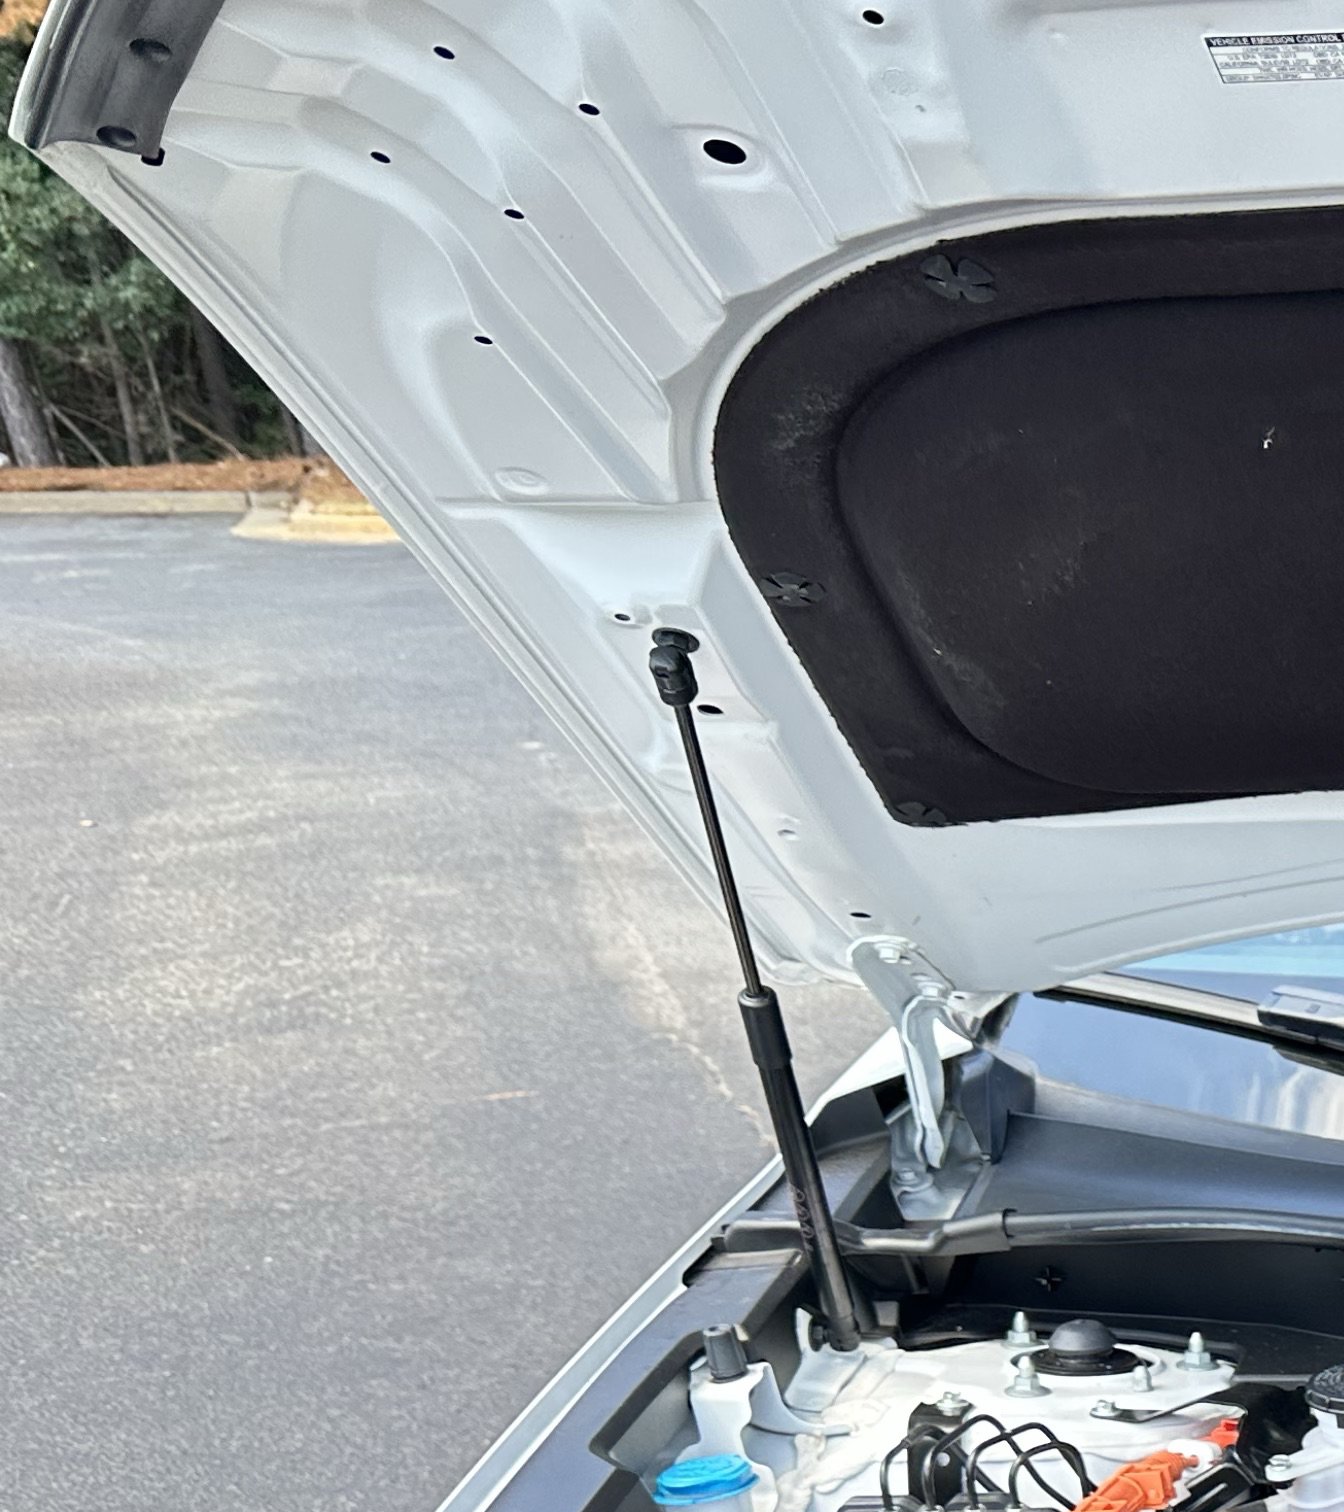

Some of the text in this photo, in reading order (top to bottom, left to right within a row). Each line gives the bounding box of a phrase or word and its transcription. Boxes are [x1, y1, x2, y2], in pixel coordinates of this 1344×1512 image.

[1210, 36, 1250, 46] VEHICLE
[1250, 36, 1295, 45] EMISSION
[1295, 33, 1342, 43] CONTROL
